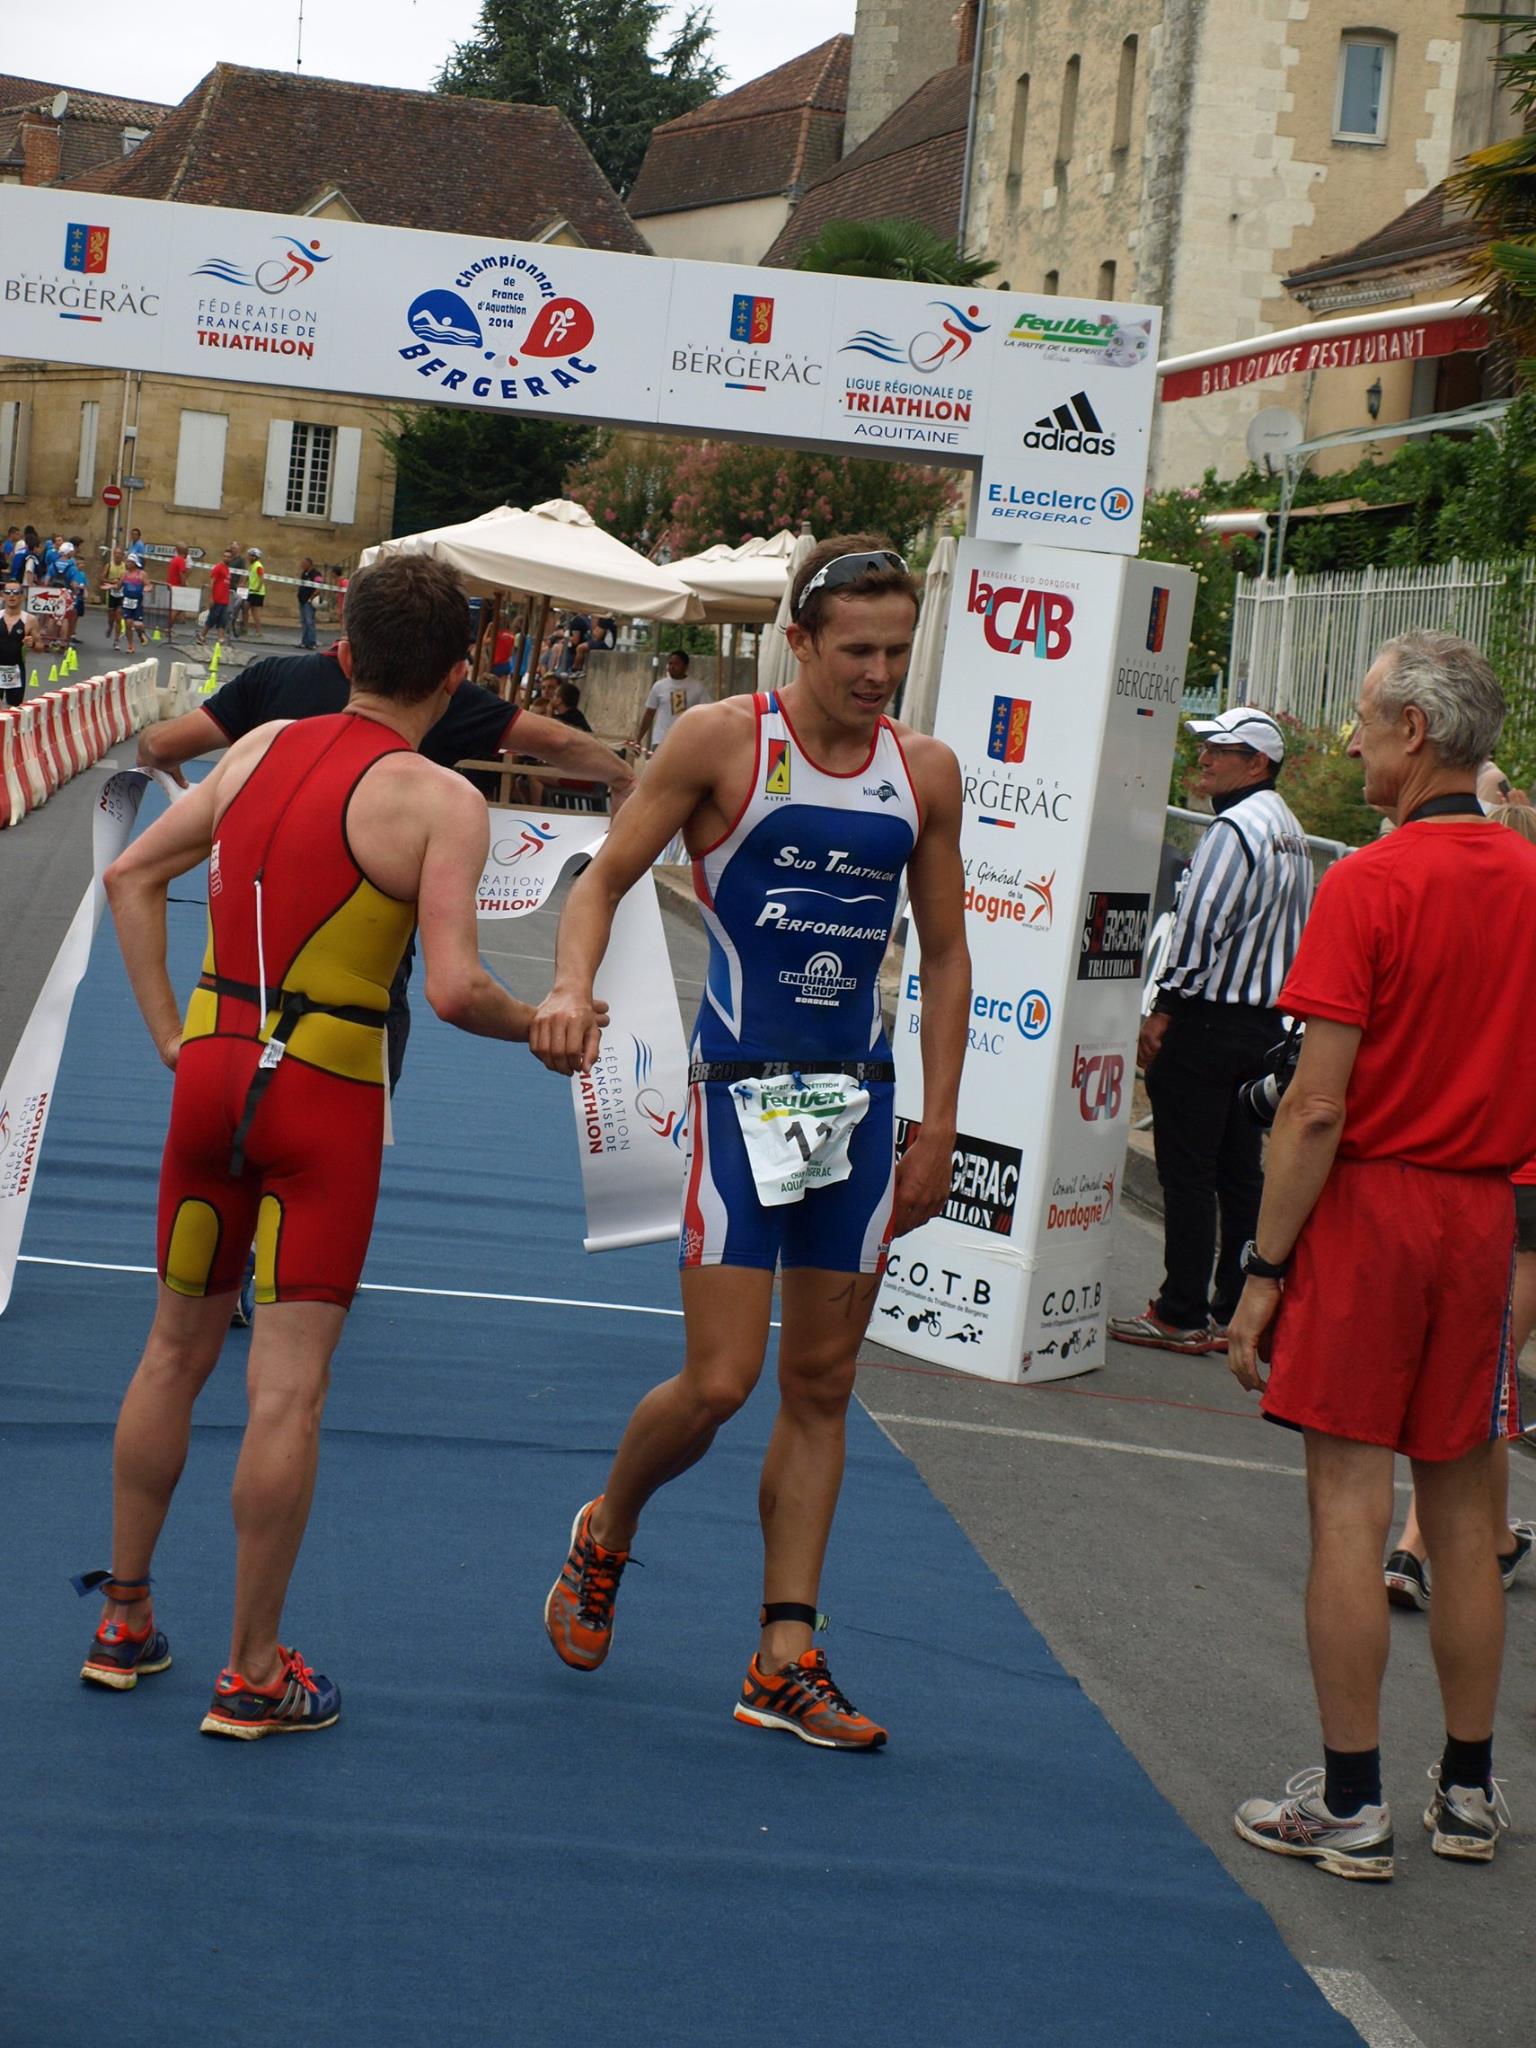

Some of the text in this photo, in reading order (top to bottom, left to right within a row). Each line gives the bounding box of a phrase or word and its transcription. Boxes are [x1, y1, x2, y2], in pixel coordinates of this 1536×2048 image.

[20, 273, 146, 292] VILLE DE
[455, 254, 557, 298] Championnat
[503, 276, 516, 287] de
[5, 279, 161, 317] BERGERAC
[477, 301, 527, 315] d'Aquathlon
[492, 289, 525, 301] France
[198, 298, 318, 323] FÉDÉRATION
[488, 317, 514, 329] 2014
[197, 315, 316, 338] FRANÇAISE DE
[197, 330, 314, 358] TRIATHLON
[687, 343, 809, 362] VILLE DE
[1307, 328, 1426, 370] RESTAURANT
[398, 343, 597, 399] BERGERAC
[672, 350, 822, 385] BERGERAC
[846, 377, 973, 401] LIGUE RÉGIONALE DE
[846, 392, 971, 422] TRIATHLON
[854, 424, 960, 445] AQUITAINE
[1023, 428, 1116, 456] adidas
[988, 484, 1097, 512] E.Leclerc
[992, 507, 1093, 526] BERGERAC
[982, 570, 1017, 582] BERGERAC
[1020, 575, 1036, 584] SUD
[1117, 667, 1180, 704] BERGERAC
[963, 764, 1060, 789] ILLE DE
[963, 776, 1072, 822] RGERAC
[773, 846, 896, 882] SUD TRIATHLON
[482, 874, 545, 886] RATION
[526, 888, 542, 897] DE
[476, 898, 539, 911] THLON
[964, 886, 1026, 922] dogne
[755, 901, 887, 942] PERFORMANCE
[780, 972, 857, 989] ENDURANCE
[803, 985, 837, 997] SHOP
[30, 1095, 39, 1112] DE
[595, 1056, 617, 1152] ANÇAISE DE
[604, 1045, 631, 1151] FÉDÉRATION
[579, 1073, 603, 1154] IATHLON
[17, 1092, 48, 1196] TRIATHLON
[951, 1150, 1019, 1208] GERAC
[1047, 1201, 1102, 1231] Dordogne
